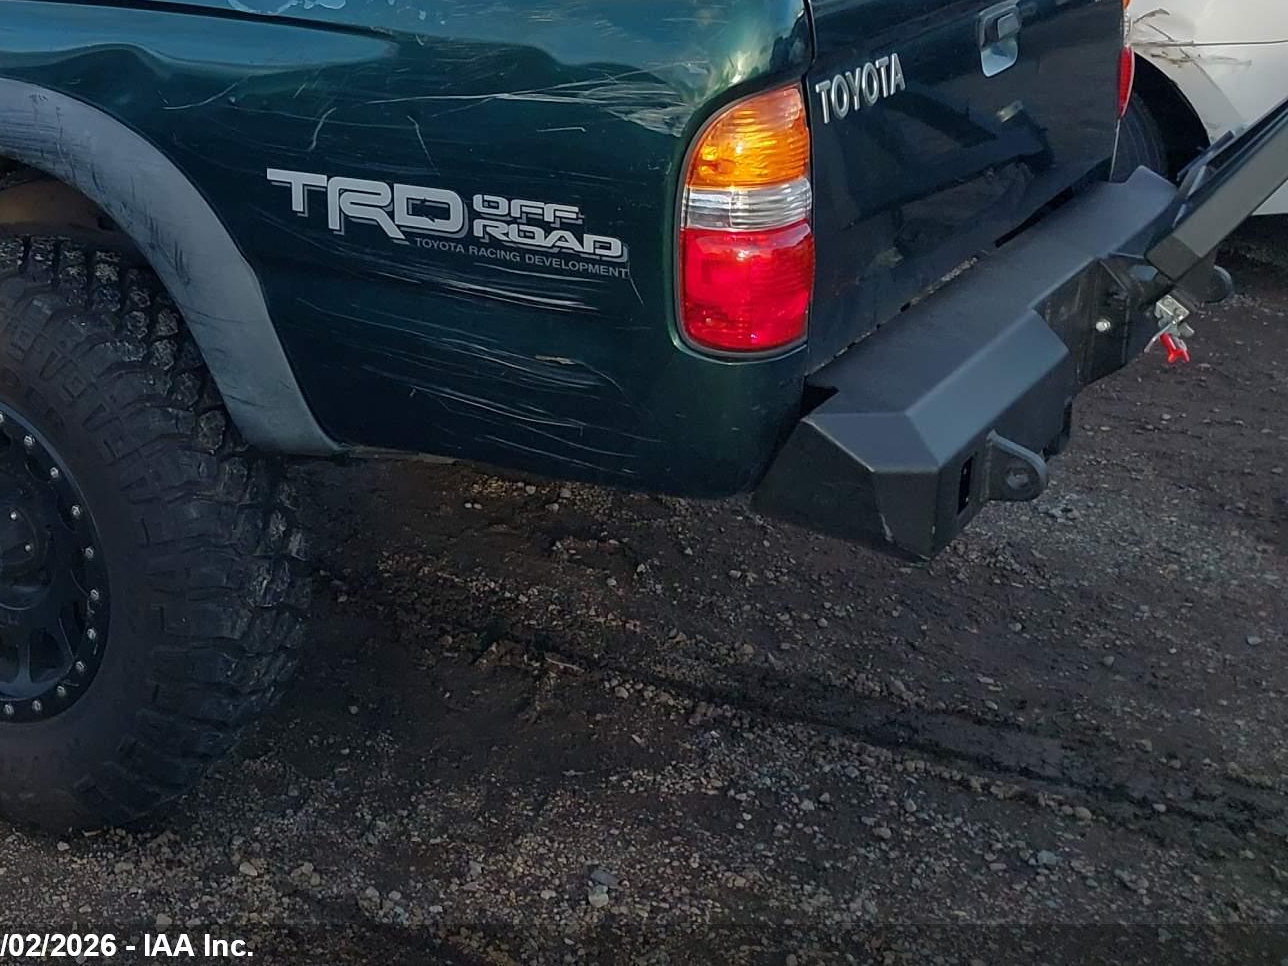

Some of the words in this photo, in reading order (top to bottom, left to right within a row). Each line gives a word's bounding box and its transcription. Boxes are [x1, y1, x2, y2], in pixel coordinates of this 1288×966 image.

[815, 52, 906, 125] TOYOTA
[266, 167, 469, 245] TRD
[472, 193, 585, 226] OFF
[414, 237, 465, 255] TOYOTA
[469, 245, 521, 263] RACING
[525, 253, 630, 279] DEVELOPMENT
[472, 219, 629, 262] ROAD
